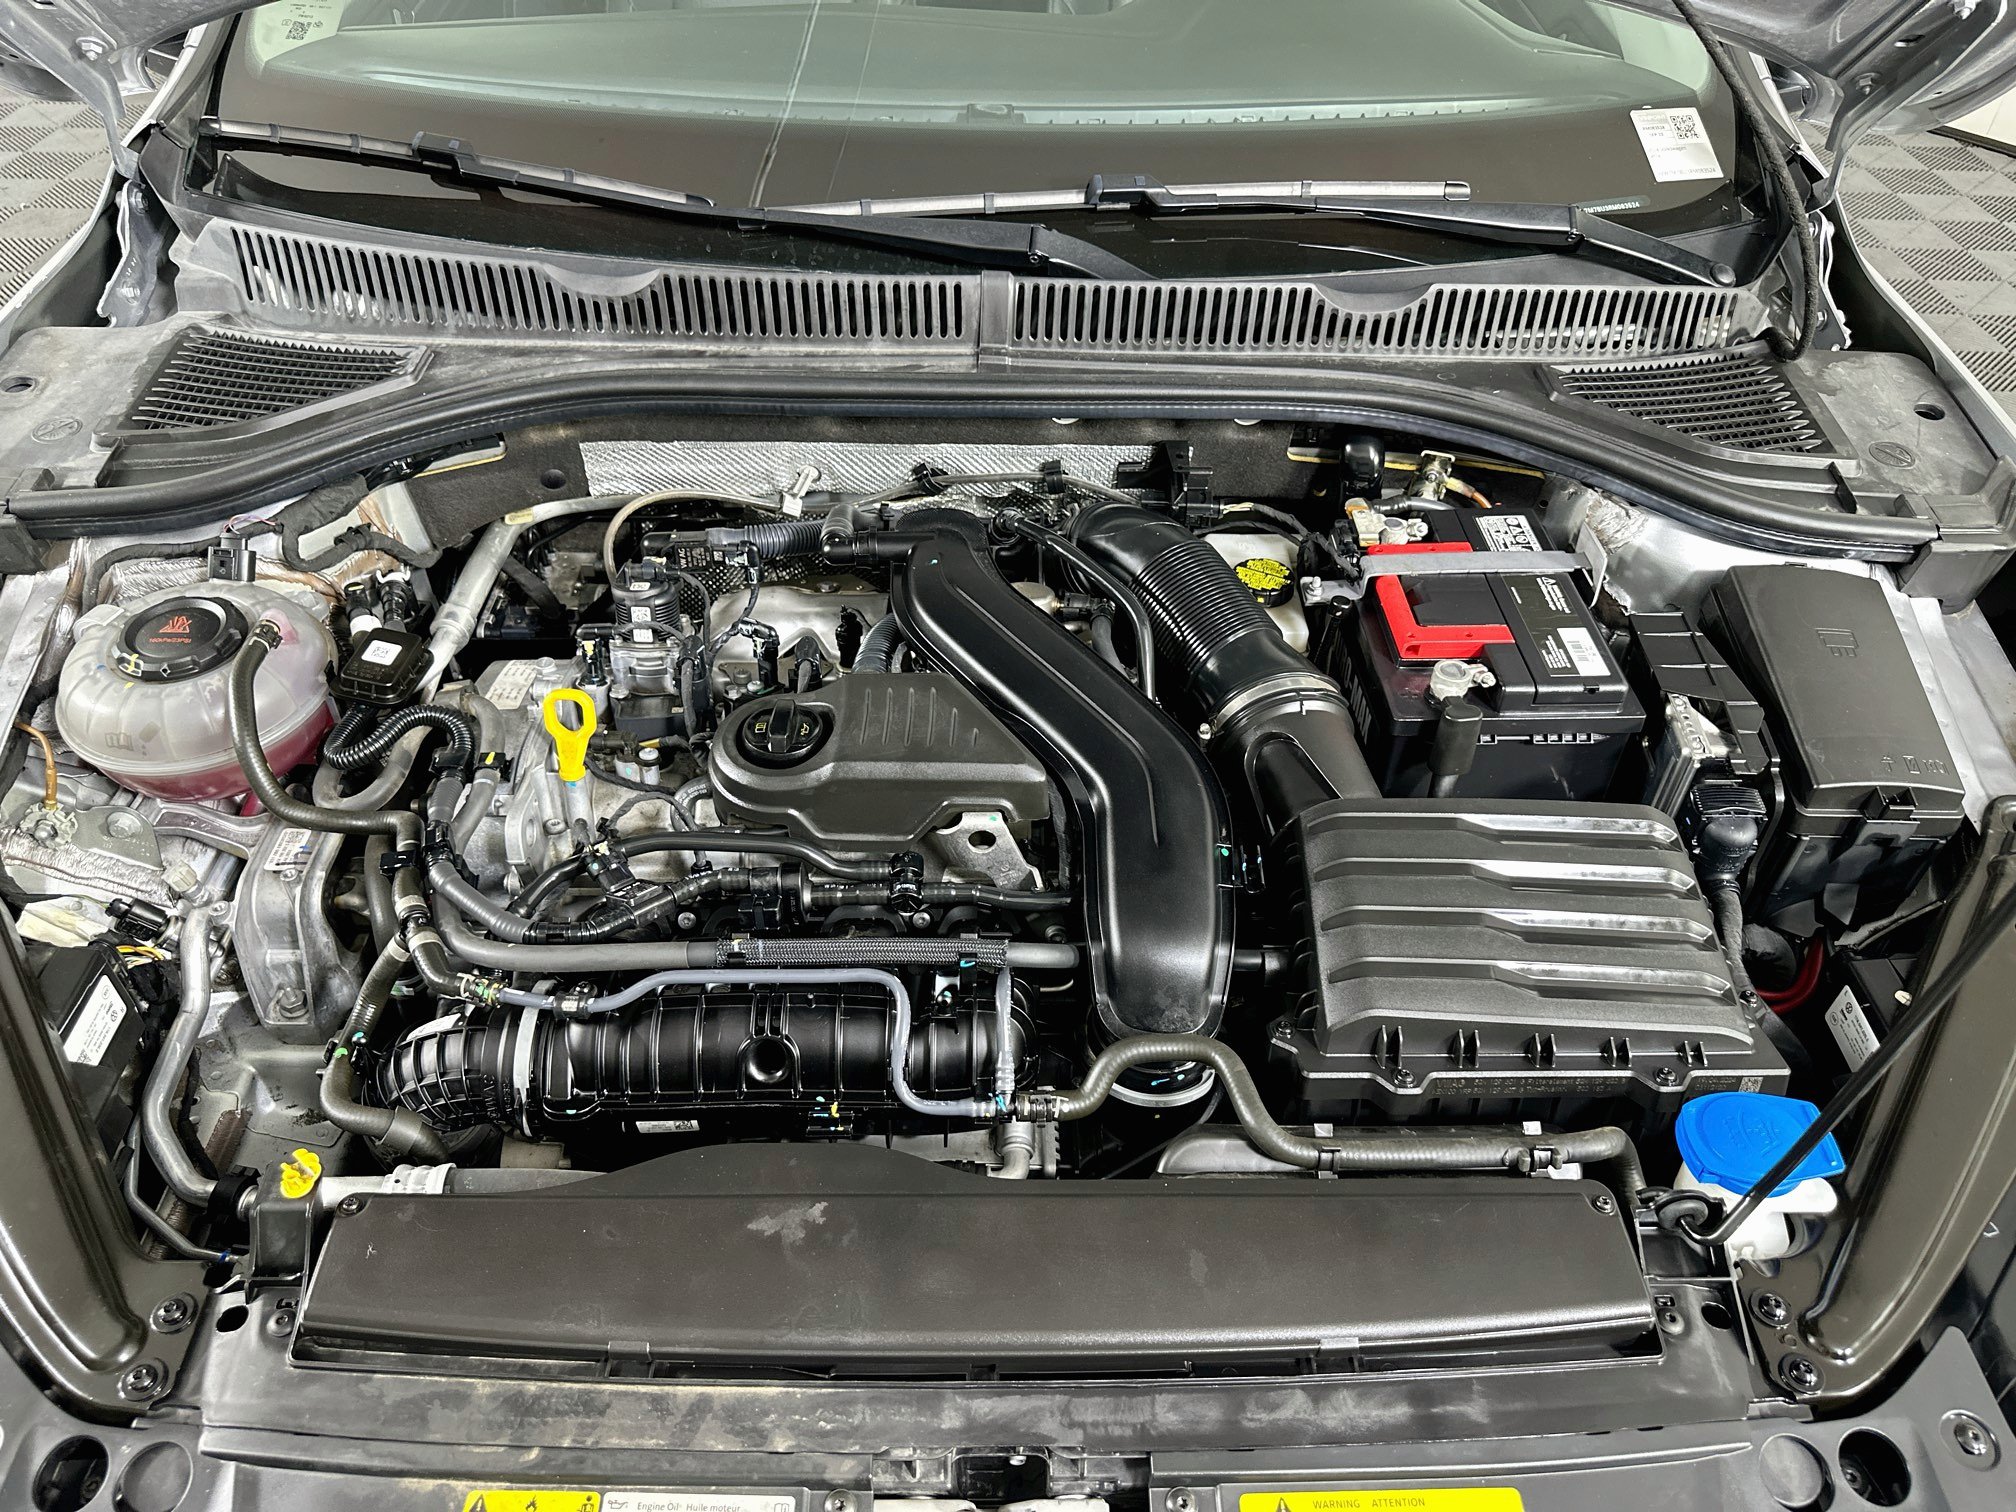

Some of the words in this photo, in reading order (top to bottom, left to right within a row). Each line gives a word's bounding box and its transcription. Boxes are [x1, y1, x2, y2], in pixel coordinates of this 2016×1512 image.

[637, 1502, 665, 1512] Engine
[686, 1503, 708, 1512] Huile
[710, 1504, 741, 1512] moteur
[1313, 1499, 1361, 1509] WARNING
[1371, 1498, 1426, 1508] ATTENTION
